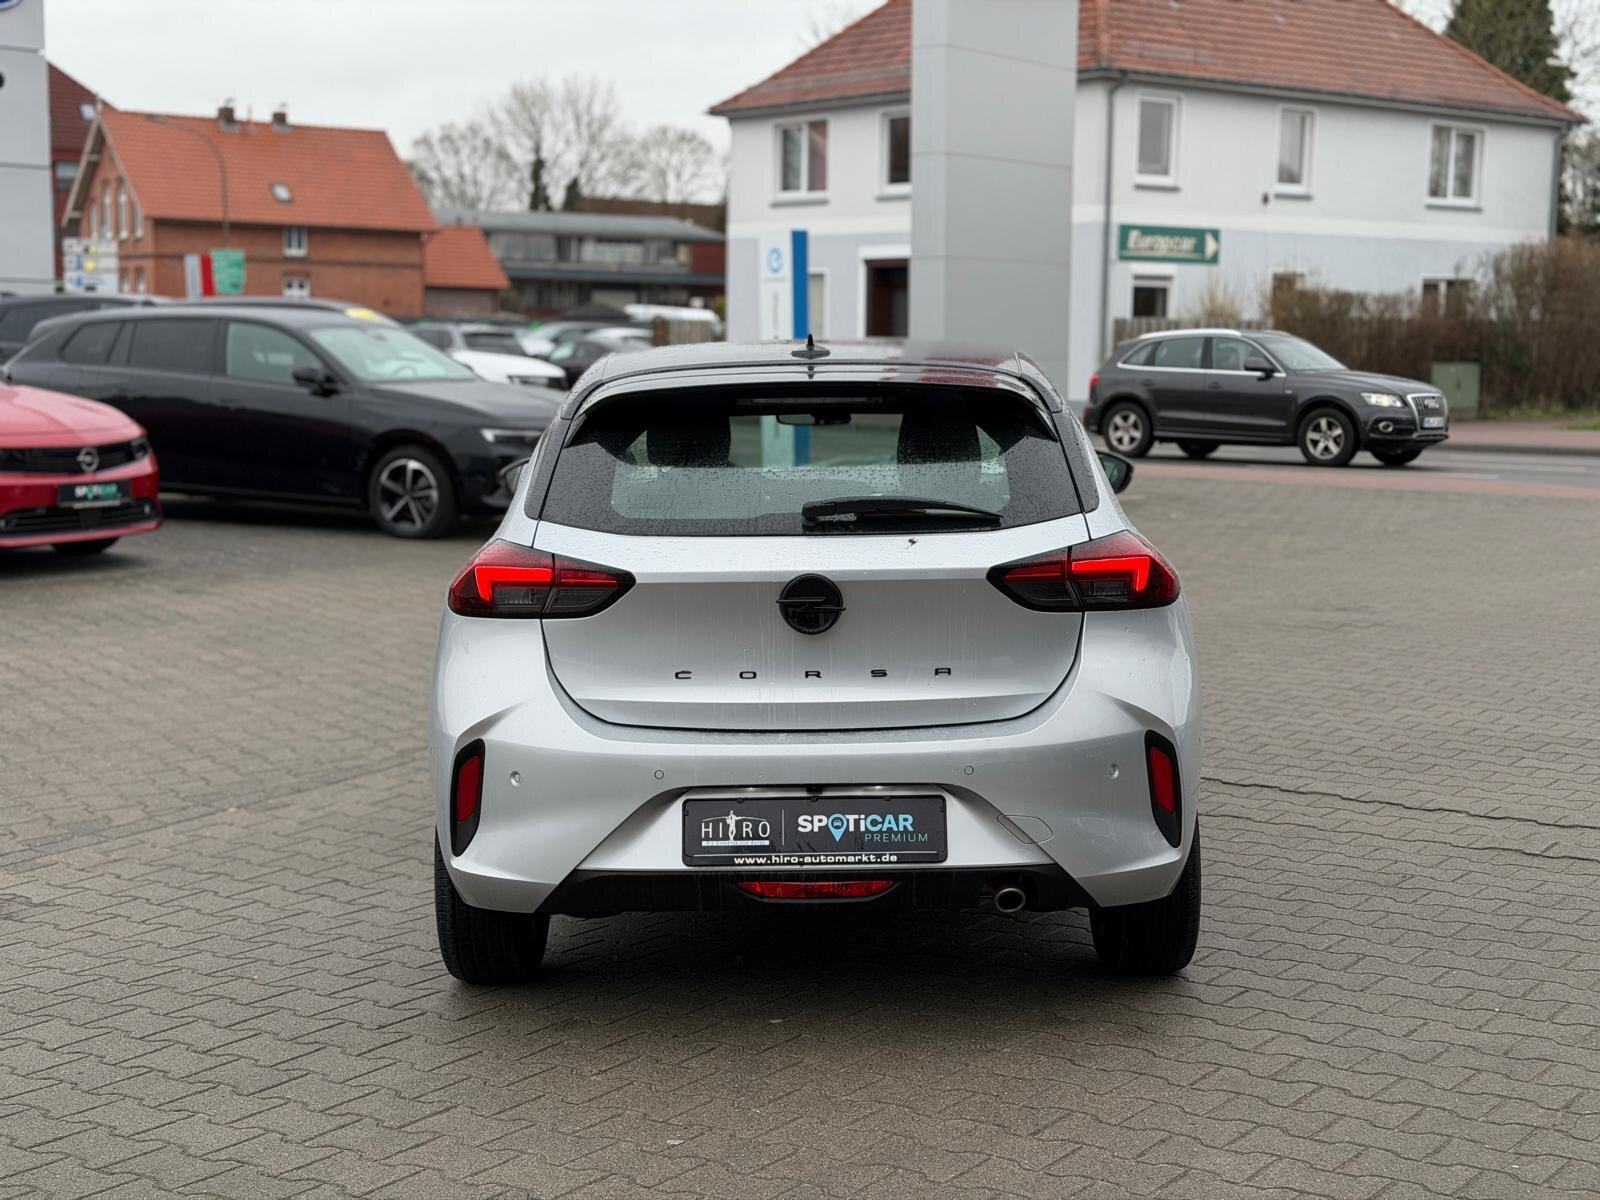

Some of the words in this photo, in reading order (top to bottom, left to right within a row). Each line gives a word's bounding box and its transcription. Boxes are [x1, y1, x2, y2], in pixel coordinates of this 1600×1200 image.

[674, 666, 952, 680] CORSA
[701, 821, 771, 839] HIRO
[864, 832, 929, 843] PREMIUM
[733, 853, 898, 866] www.hiro-automarkt.de
